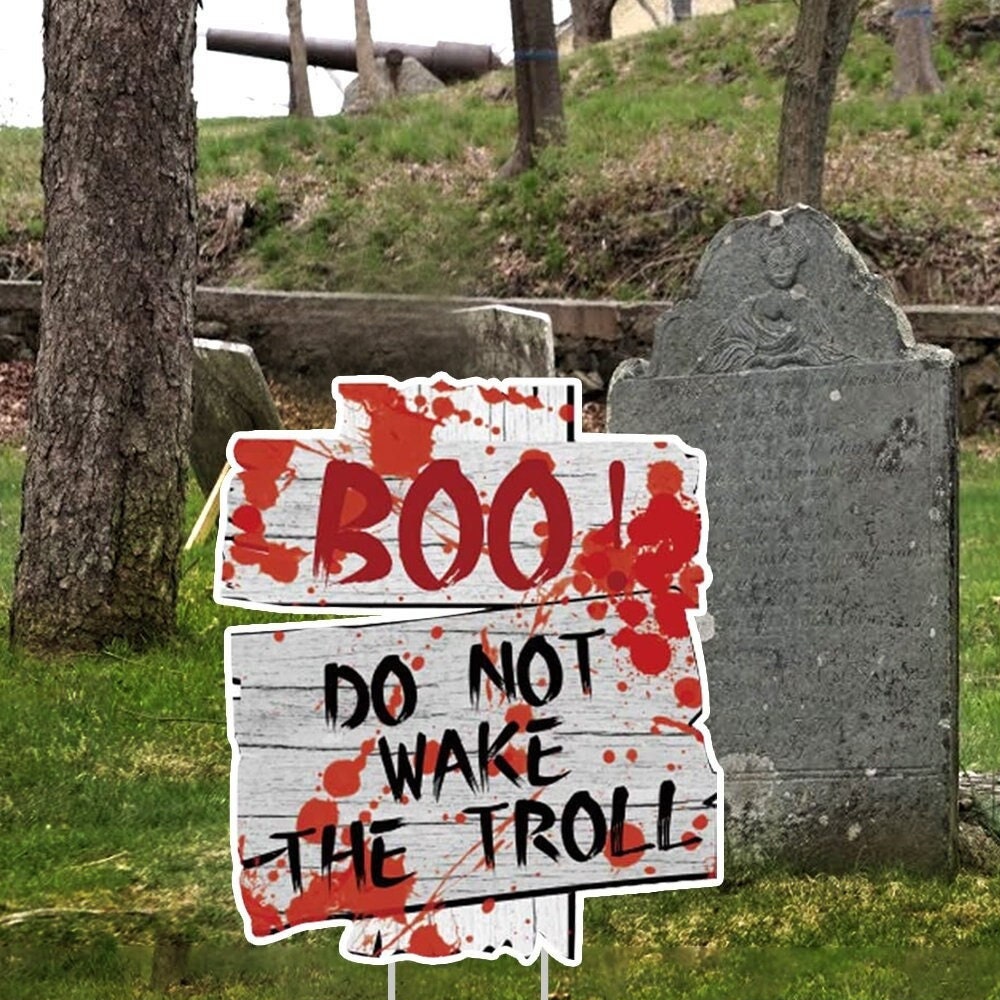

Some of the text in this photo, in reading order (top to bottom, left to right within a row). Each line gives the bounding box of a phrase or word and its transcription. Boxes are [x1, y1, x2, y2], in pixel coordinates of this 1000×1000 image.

[324, 628, 605, 732] DO NOT
[378, 714, 571, 803] WAKE
[269, 779, 702, 895] THE TROLL
